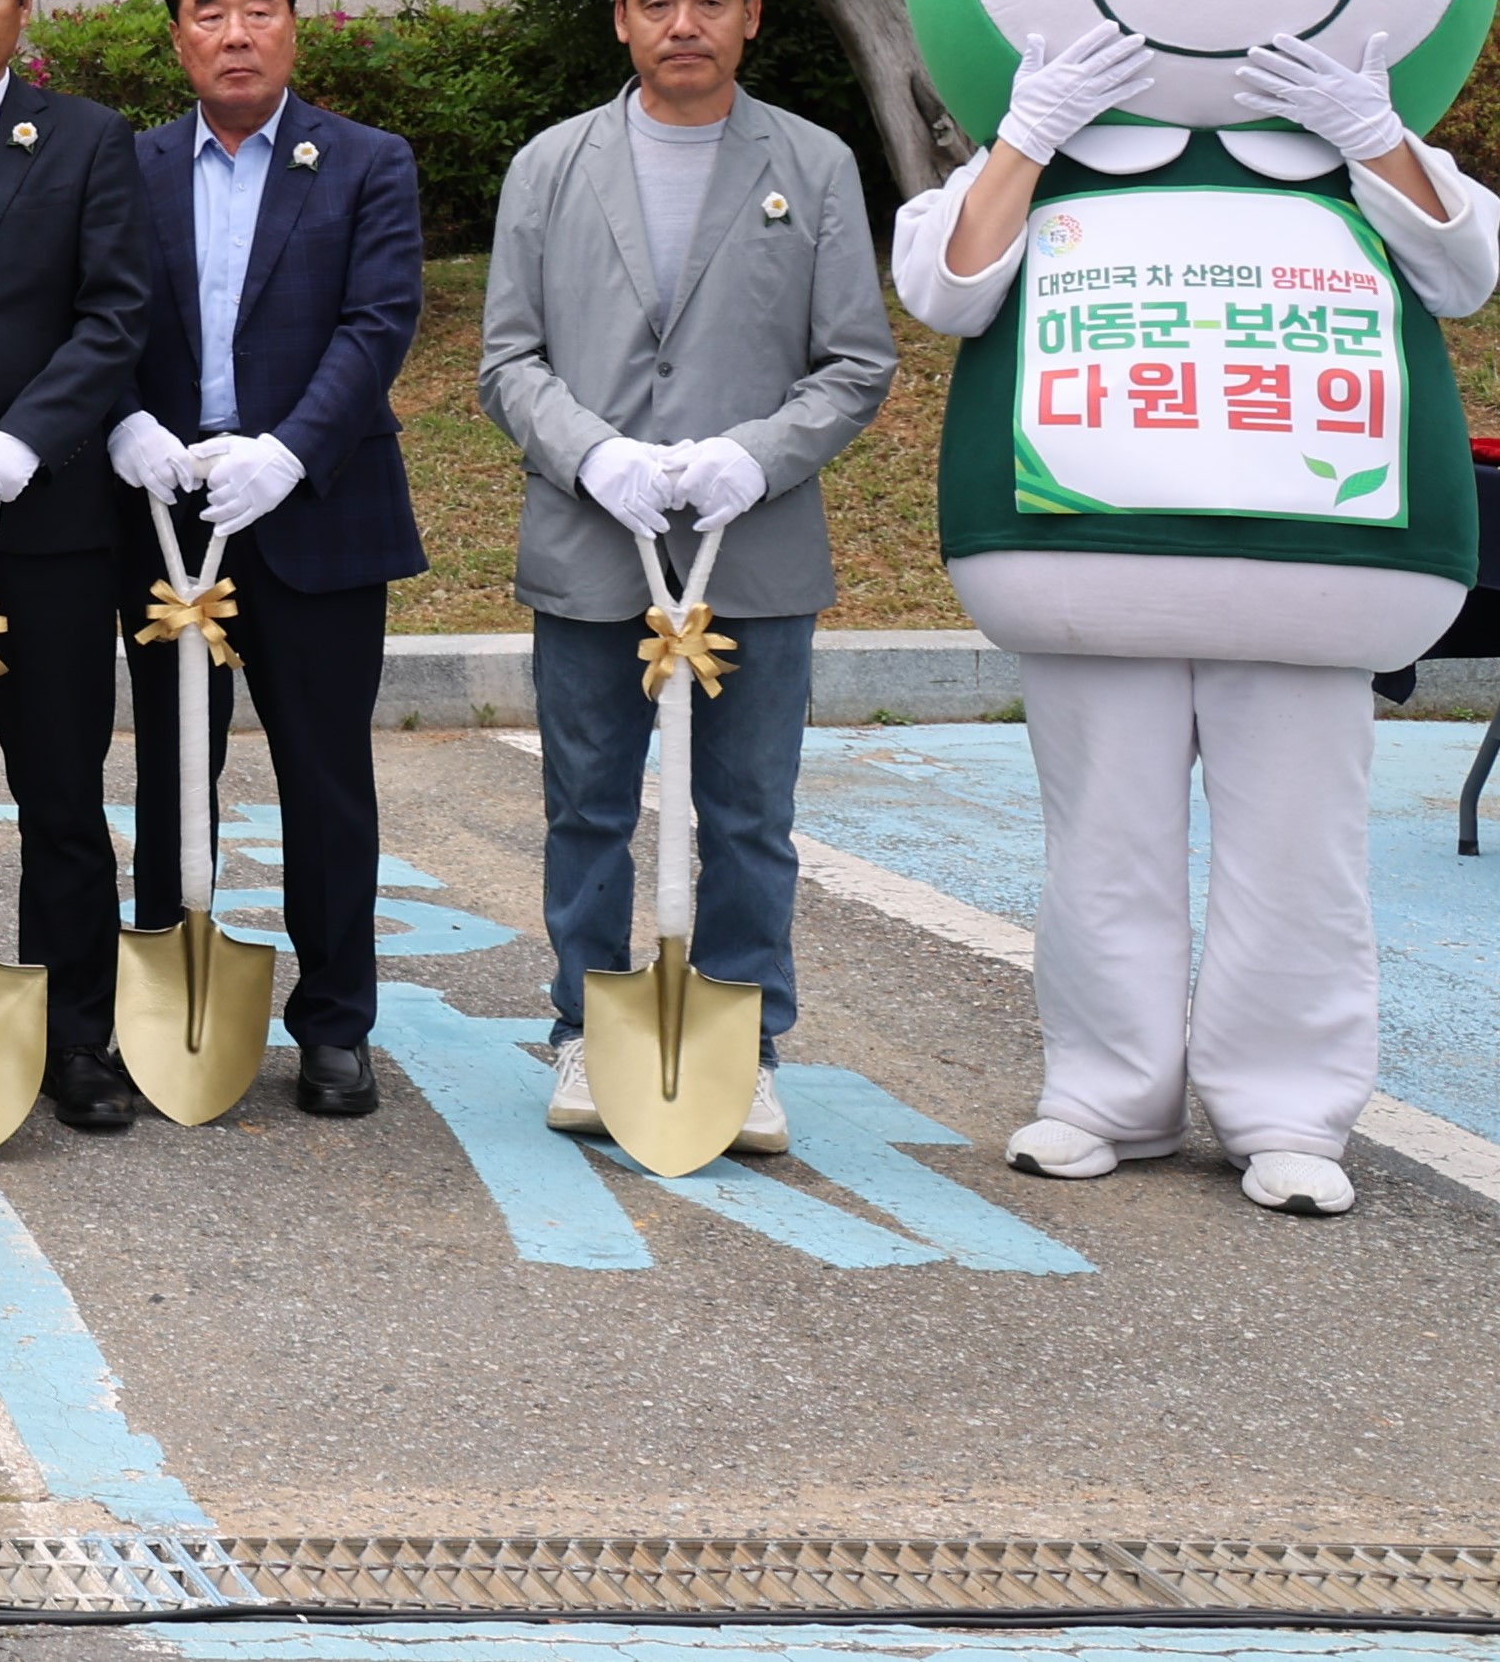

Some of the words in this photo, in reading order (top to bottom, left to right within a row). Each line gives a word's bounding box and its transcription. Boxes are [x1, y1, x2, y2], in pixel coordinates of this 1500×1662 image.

[1038, 265, 1137, 297] 대한민국
[1146, 265, 1173, 288] 차
[1182, 264, 1262, 289] 산업의
[1272, 266, 1379, 295] 양대산맥
